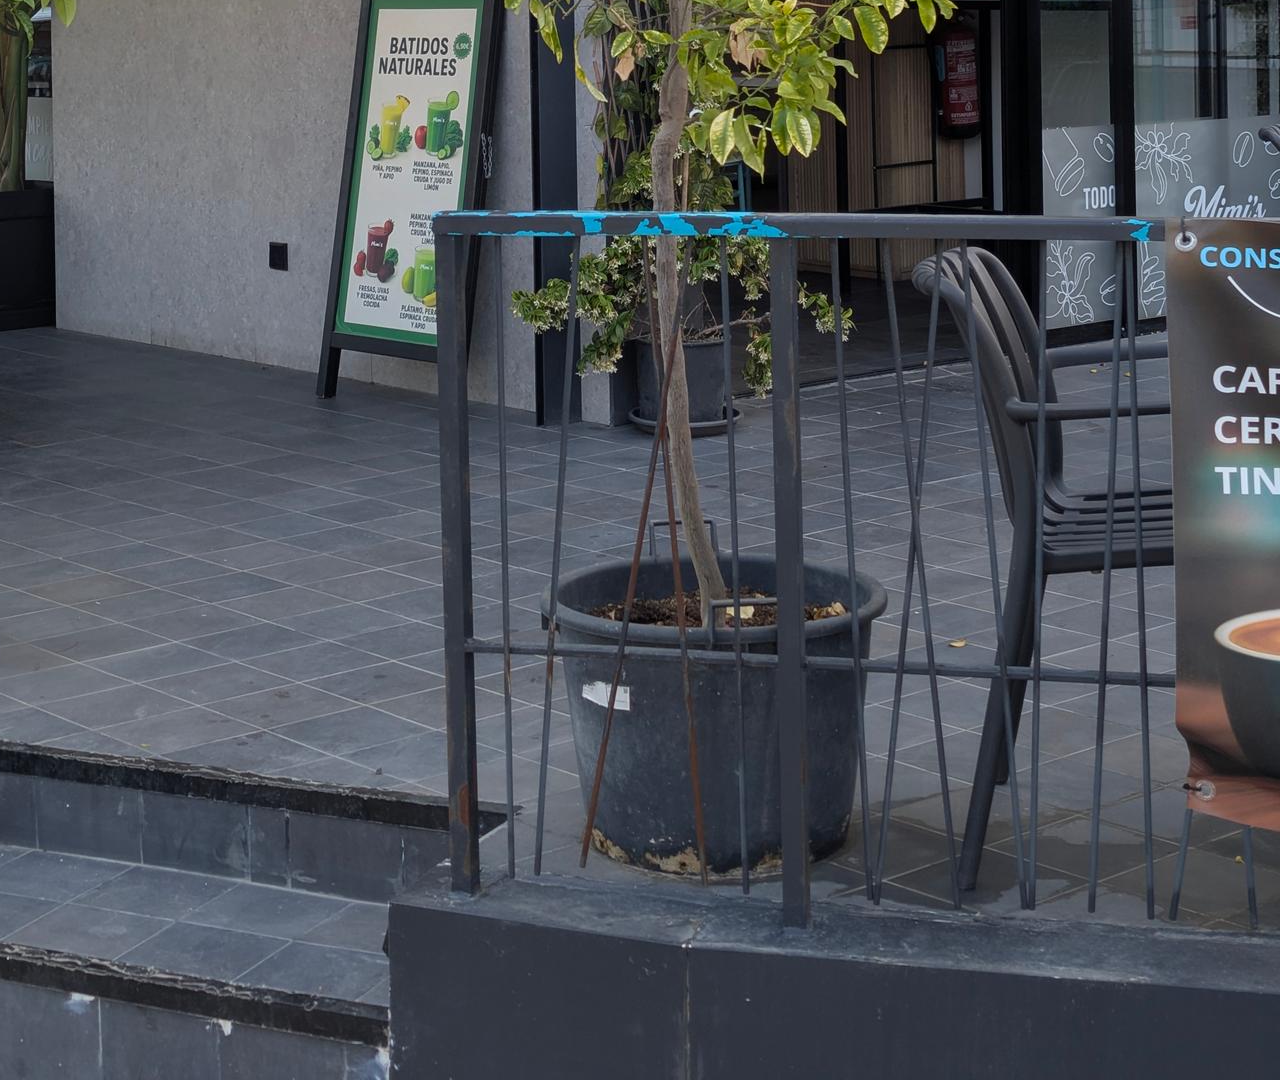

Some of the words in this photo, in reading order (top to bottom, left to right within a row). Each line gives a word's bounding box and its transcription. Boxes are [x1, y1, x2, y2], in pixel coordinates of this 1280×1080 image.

[390, 37, 449, 55] BATIDOS
[378, 57, 457, 76] NATURALES
[1184, 184, 1266, 218] Mimi's
